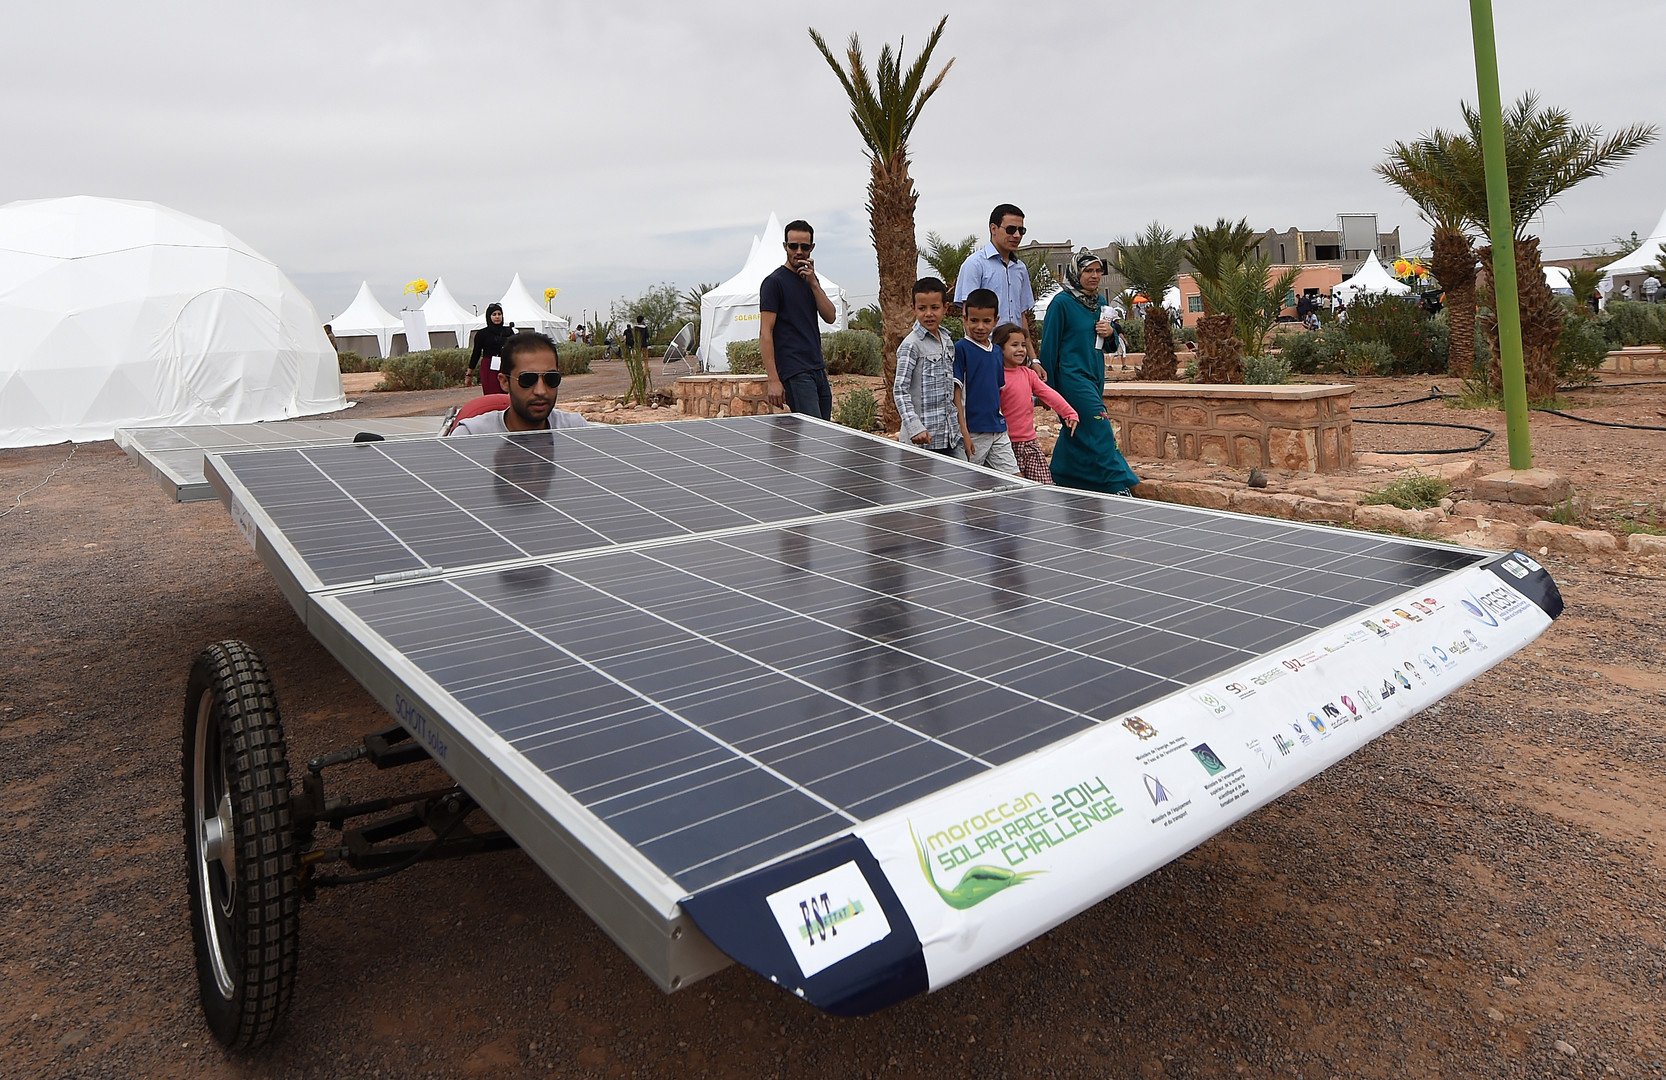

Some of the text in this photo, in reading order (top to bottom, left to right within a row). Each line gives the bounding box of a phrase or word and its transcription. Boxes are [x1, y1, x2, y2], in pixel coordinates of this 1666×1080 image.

[1477, 583, 1521, 614] IRESEN
[395, 694, 447, 759] SCHOTT solar
[926, 791, 1042, 850] moroccan
[937, 776, 1110, 871] SOLAR RACE 2014
[1001, 796, 1124, 866] CHALLENGE
